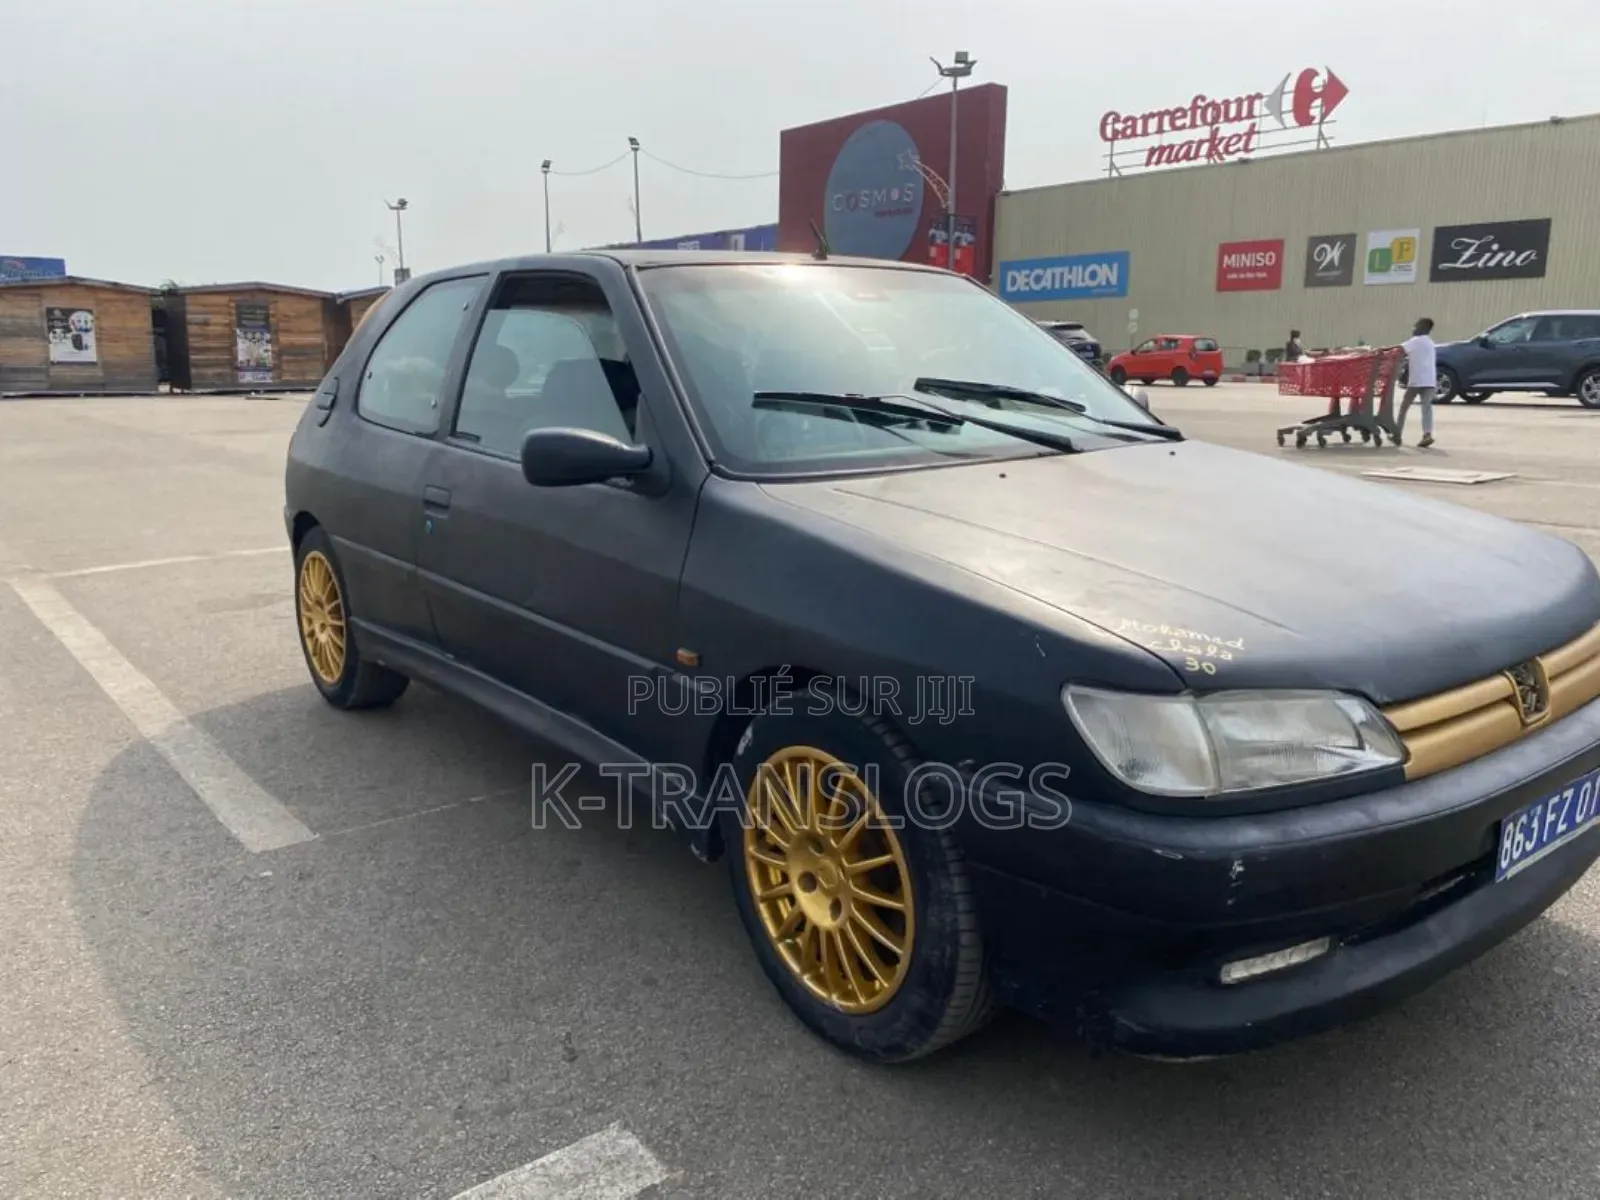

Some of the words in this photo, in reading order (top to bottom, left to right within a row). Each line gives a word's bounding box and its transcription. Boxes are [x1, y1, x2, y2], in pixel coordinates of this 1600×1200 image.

[1100, 92, 1264, 142] Carrefour
[1144, 122, 1258, 167] market
[832, 182, 915, 213] COSMOS
[1222, 251, 1276, 268] MINISO
[1437, 235, 1538, 271] Zino
[1006, 262, 1119, 293] DECATHLON
[1185, 656, 1217, 676] 30
[1500, 803, 1543, 869] 863
[1542, 787, 1575, 843] FZ
